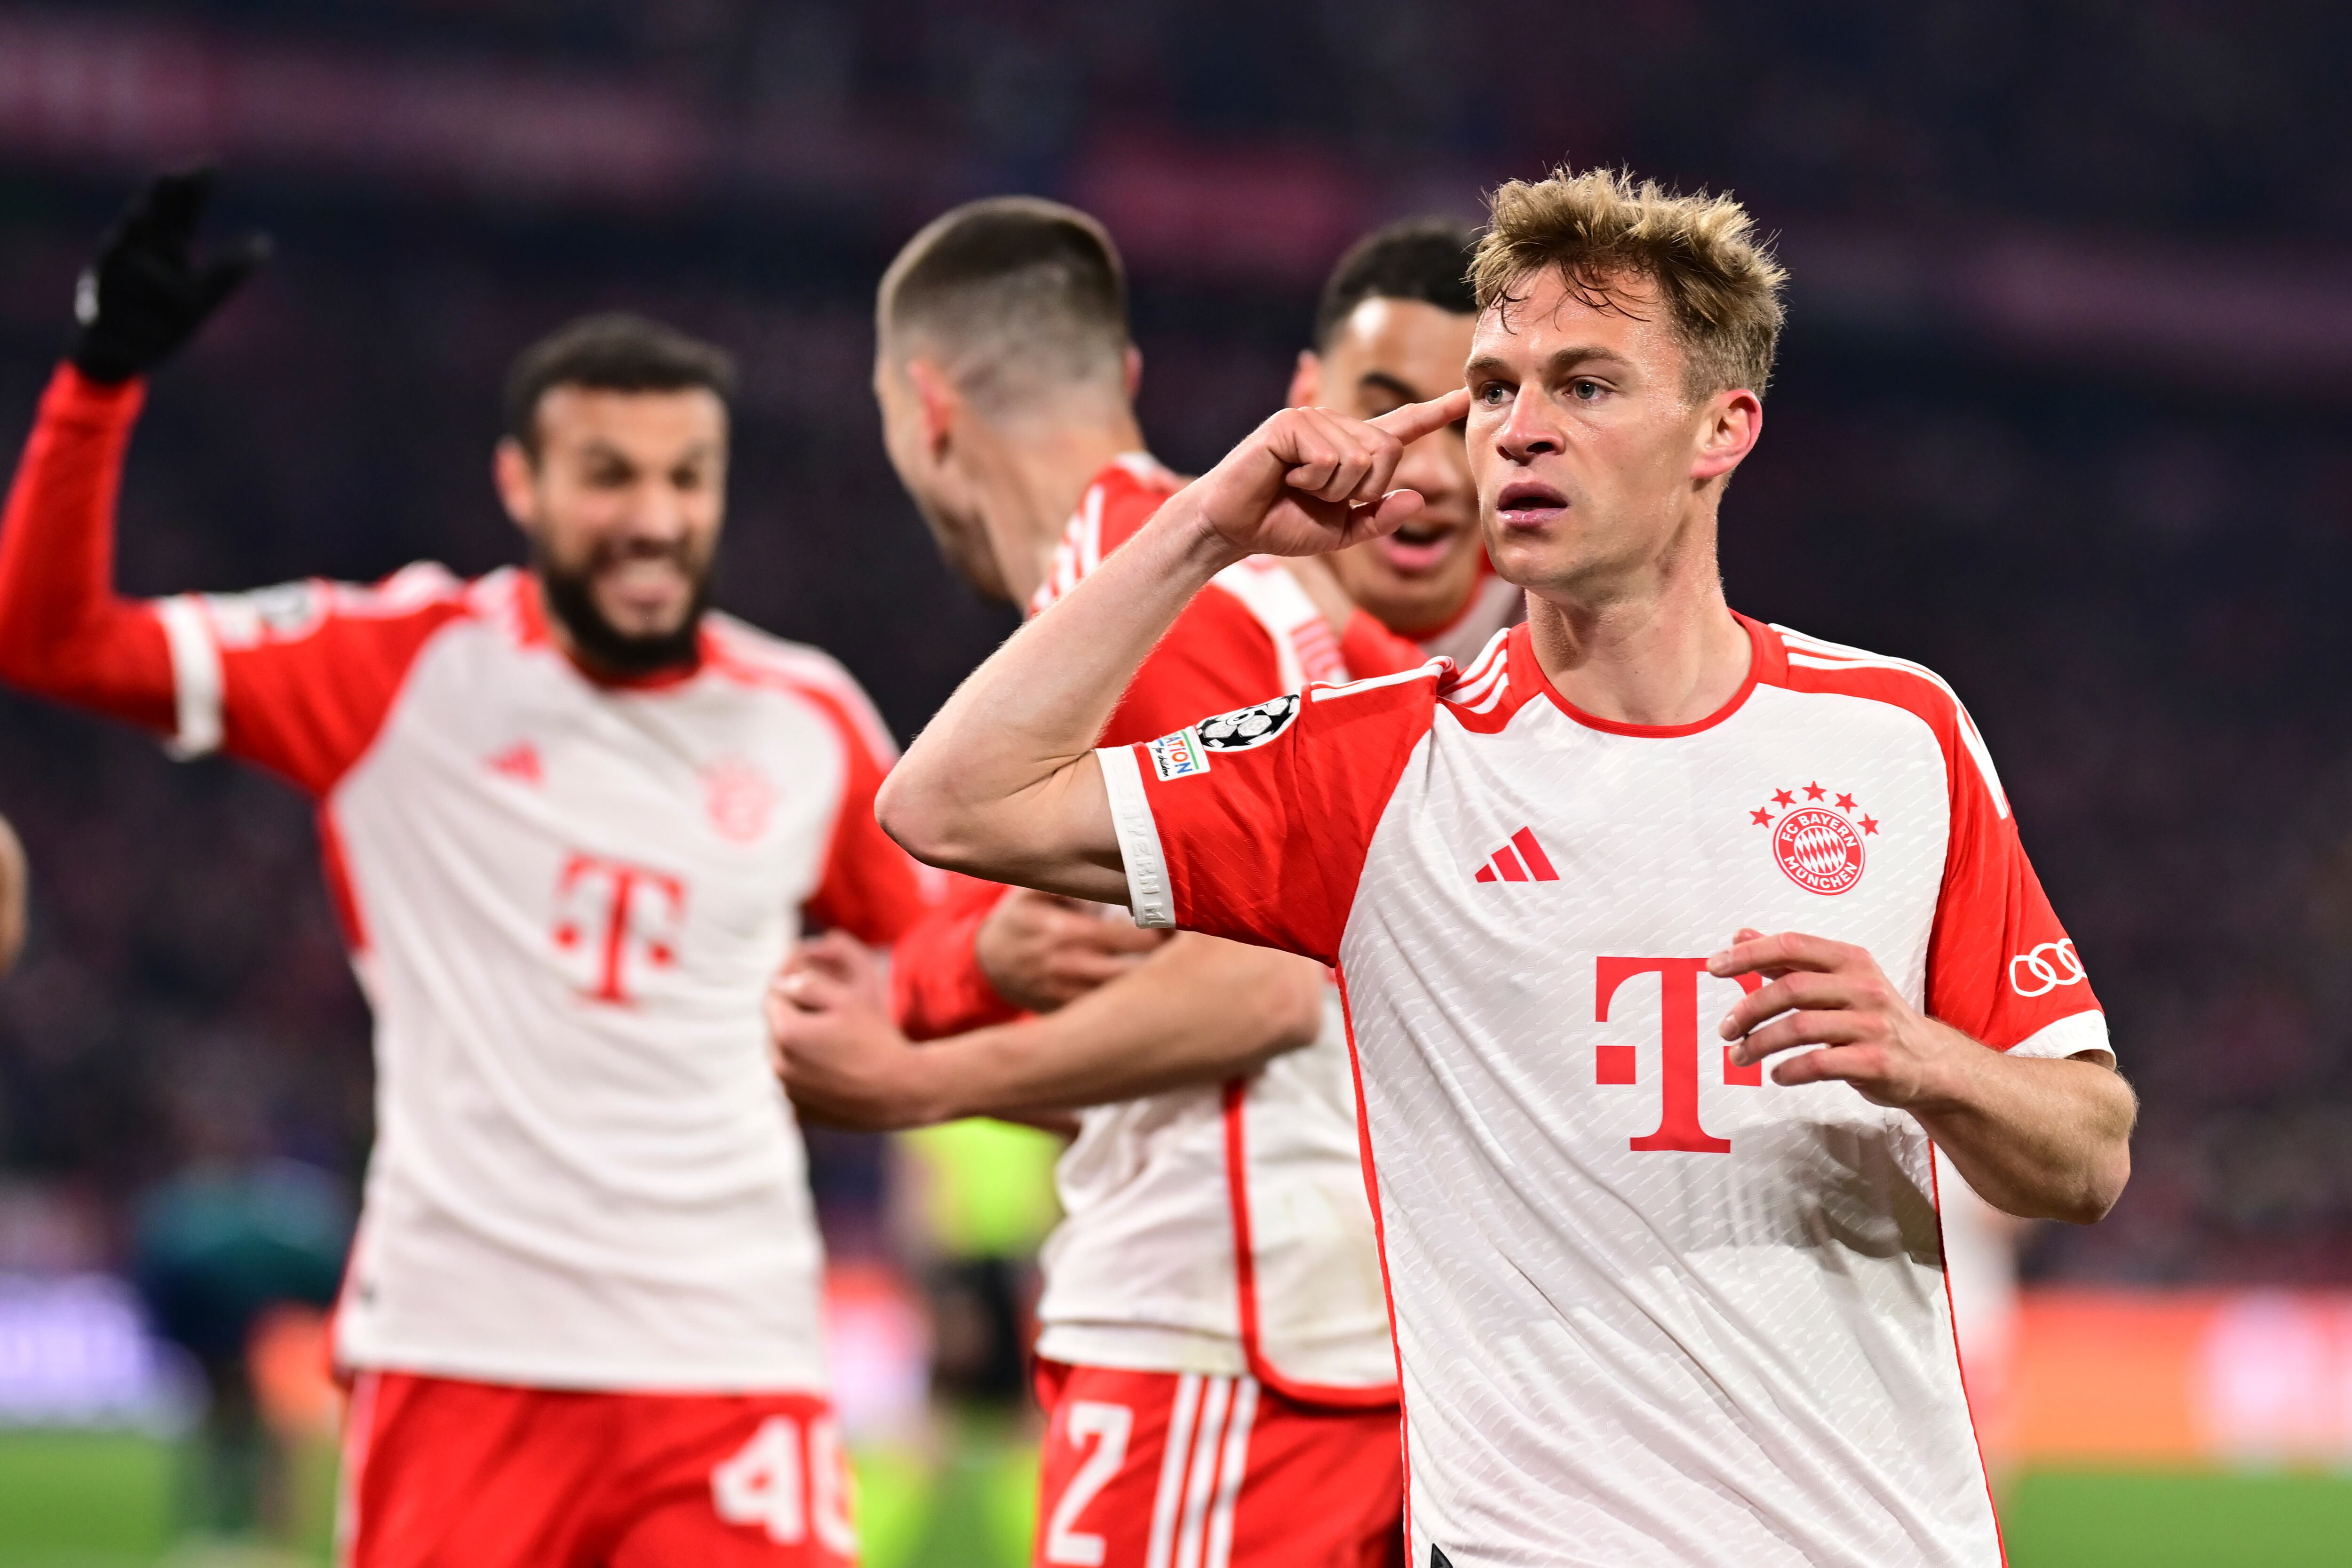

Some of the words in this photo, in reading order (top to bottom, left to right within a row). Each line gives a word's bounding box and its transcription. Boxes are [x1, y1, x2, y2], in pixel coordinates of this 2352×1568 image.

[1157, 755, 1170, 777] children
[1781, 823, 1798, 842] FC
[1797, 813, 1858, 848] BAYERN
[1784, 855, 1858, 889] MÜNCHEN
[553, 848, 688, 1010] T
[1596, 956, 1762, 1154] T
[1045, 1401, 1134, 1567] 2
